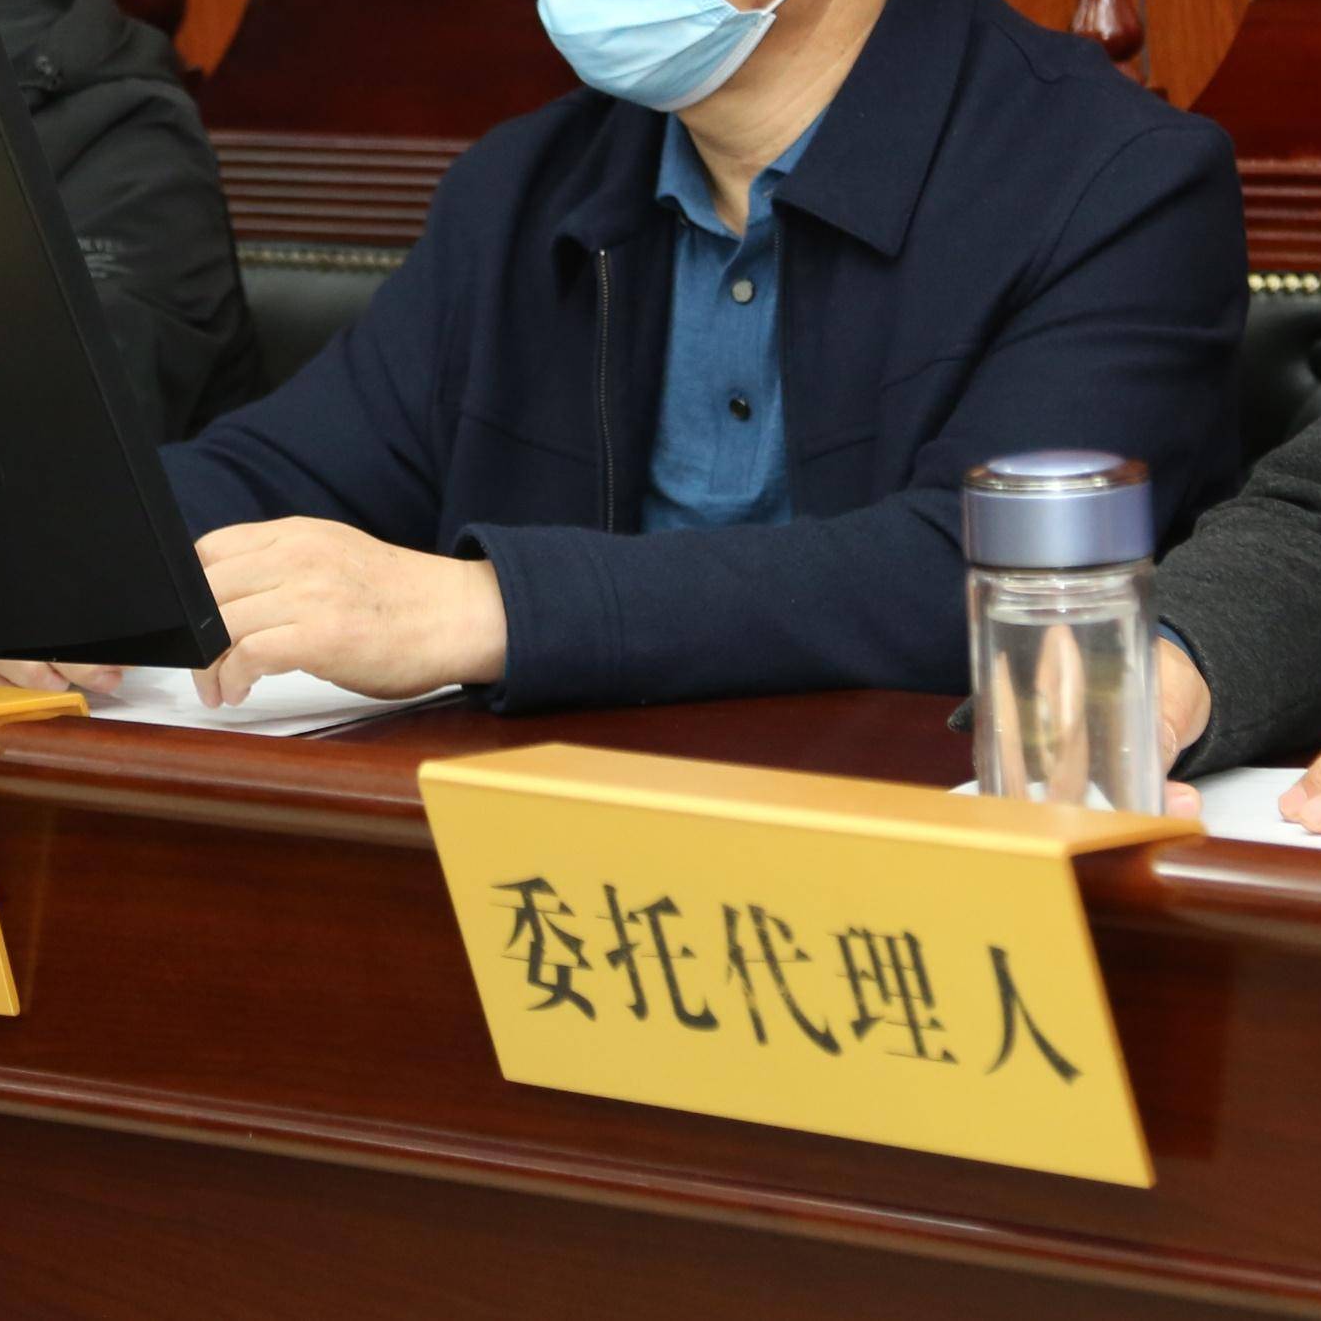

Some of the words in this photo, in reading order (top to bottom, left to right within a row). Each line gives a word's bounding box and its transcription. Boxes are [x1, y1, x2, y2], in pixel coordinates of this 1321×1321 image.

[490, 876, 1084, 1086] 委托代理人
